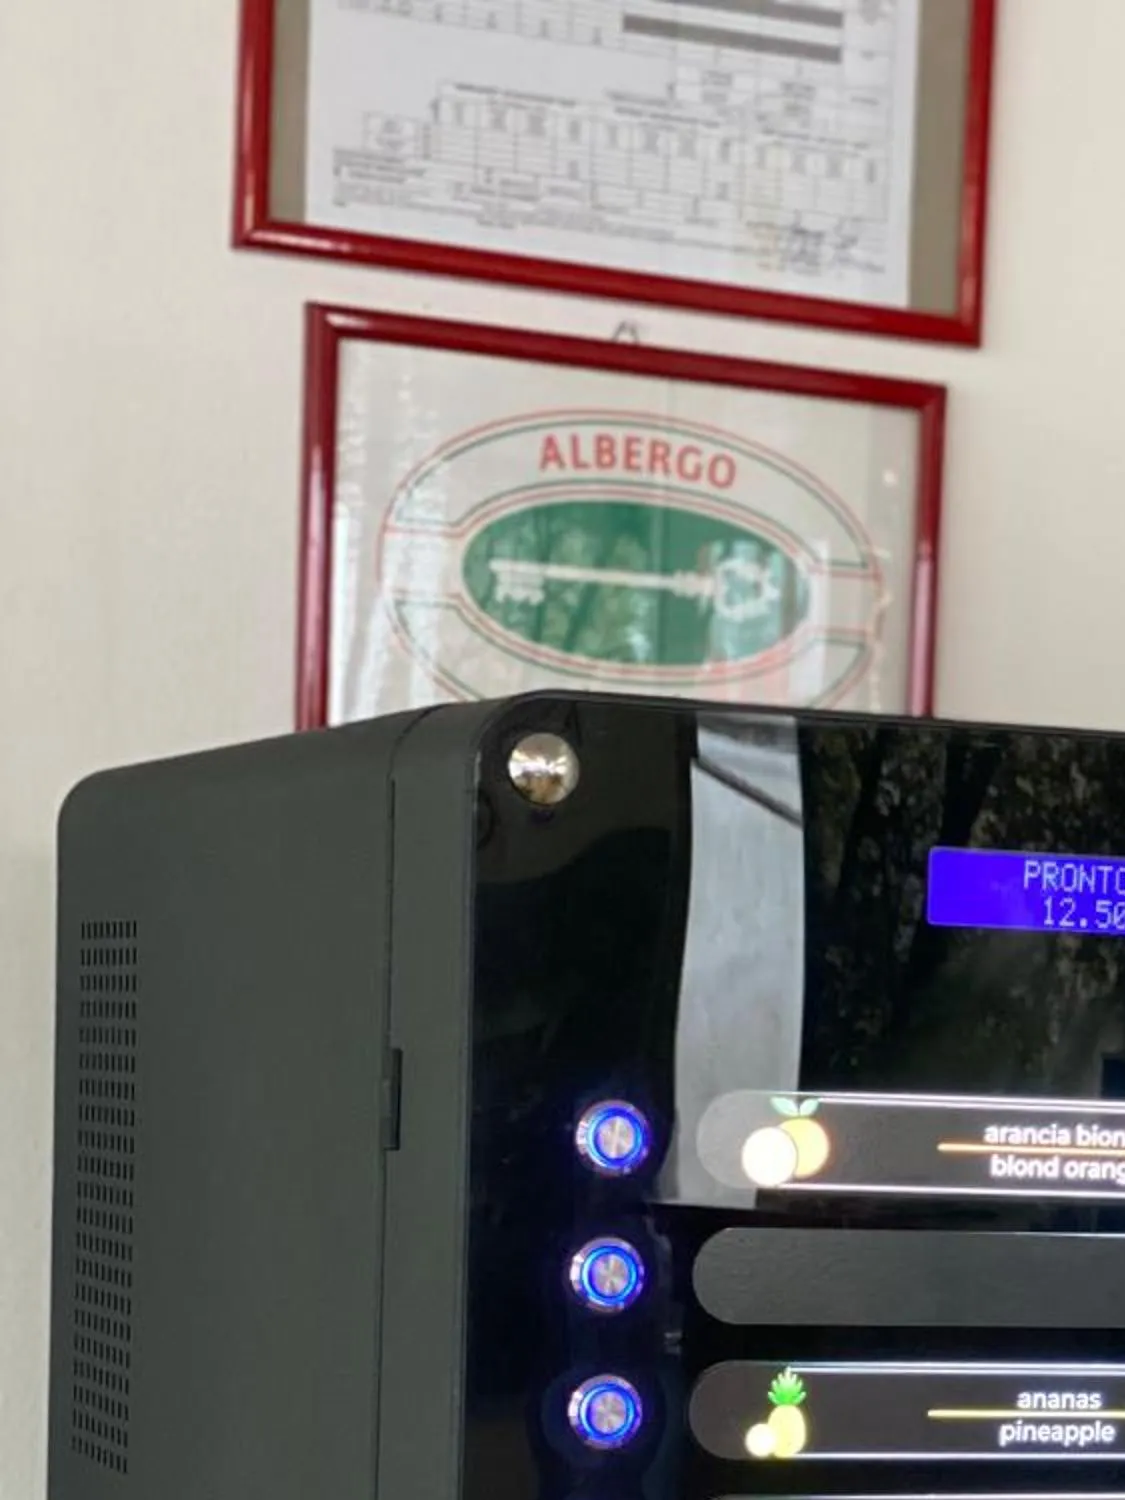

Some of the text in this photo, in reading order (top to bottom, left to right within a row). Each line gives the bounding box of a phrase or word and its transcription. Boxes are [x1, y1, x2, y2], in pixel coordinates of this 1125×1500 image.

[538, 433, 737, 489] ALBERGO
[984, 1122, 1071, 1145] arancia
[990, 1153, 1060, 1178] blond
[1016, 1390, 1102, 1409] ananas
[998, 1419, 1116, 1447] pineapple
